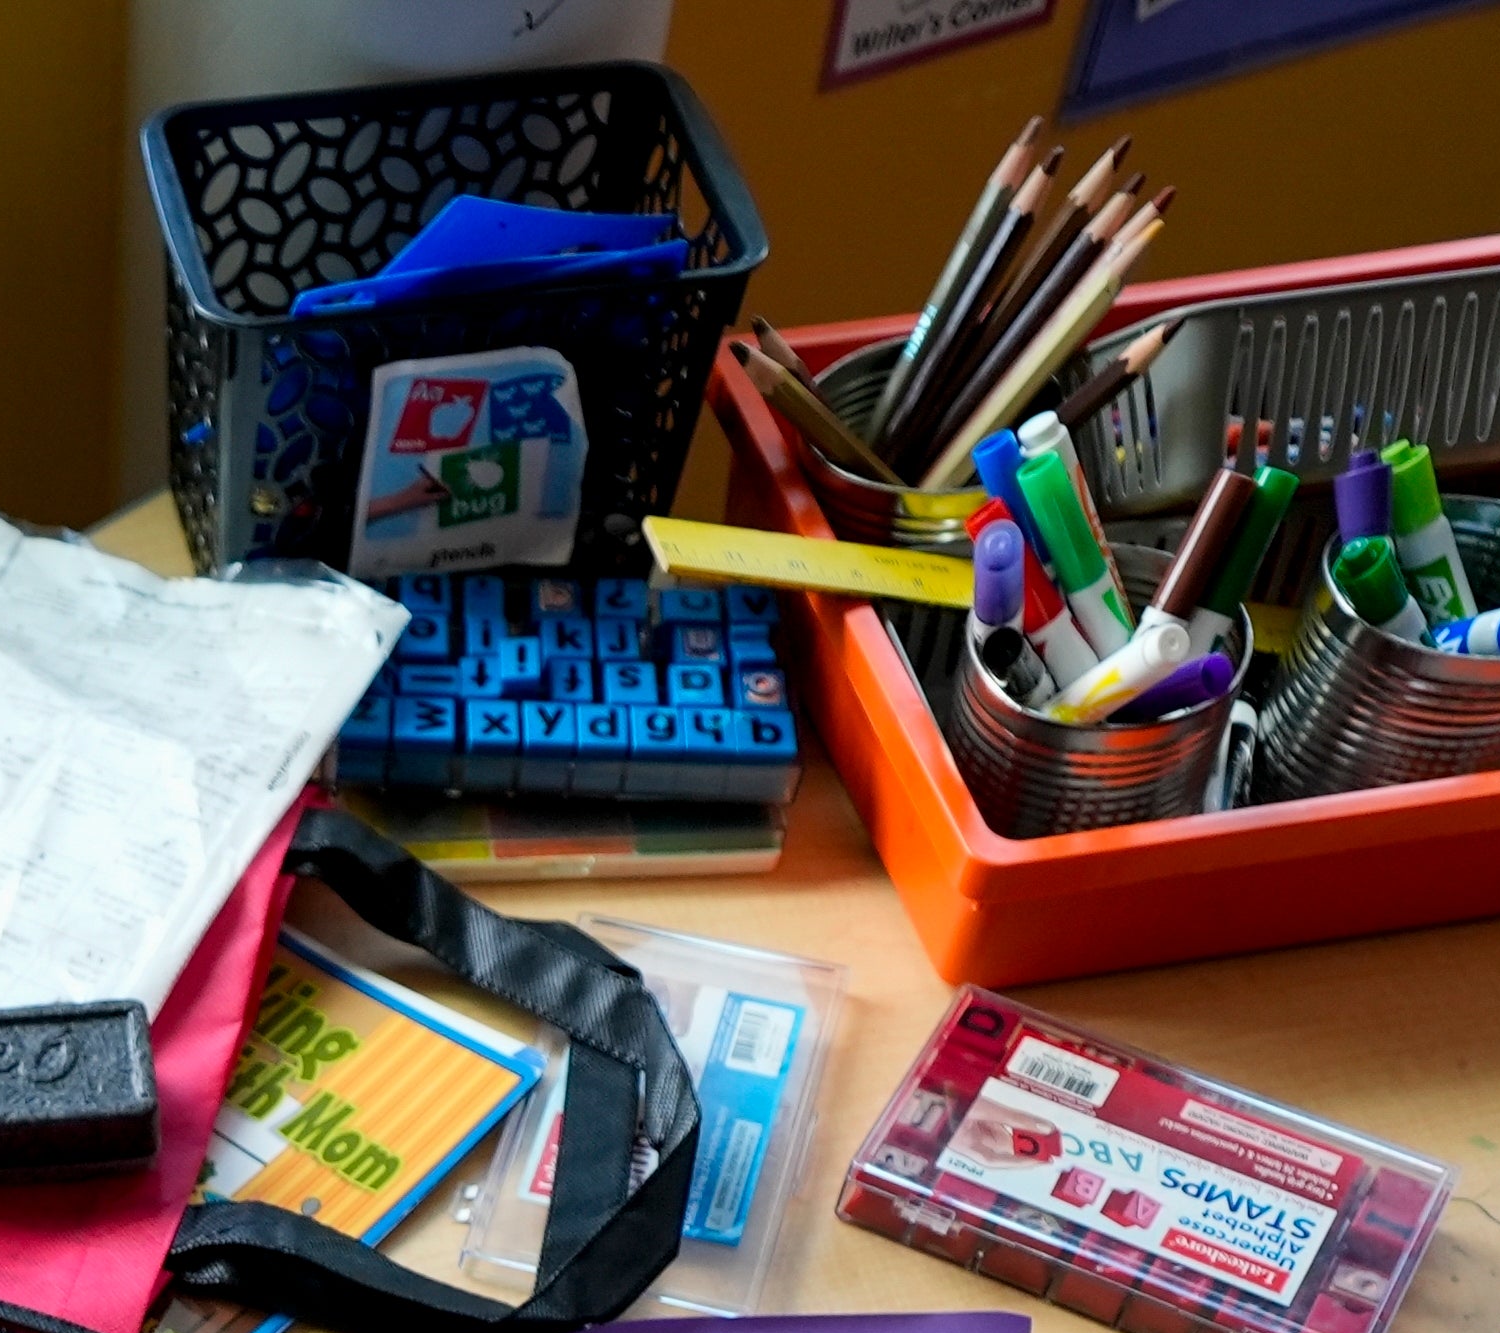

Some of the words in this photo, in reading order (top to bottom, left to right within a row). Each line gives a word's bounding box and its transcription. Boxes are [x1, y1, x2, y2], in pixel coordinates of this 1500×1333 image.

[278, 1089, 402, 1192] Mom
[1160, 1168, 1317, 1240] STAMPS
[1202, 1207, 1305, 1255] Alphabet
[1174, 1234, 1277, 1285] Lakeshore
[1178, 1216, 1296, 1272] Uppercase
